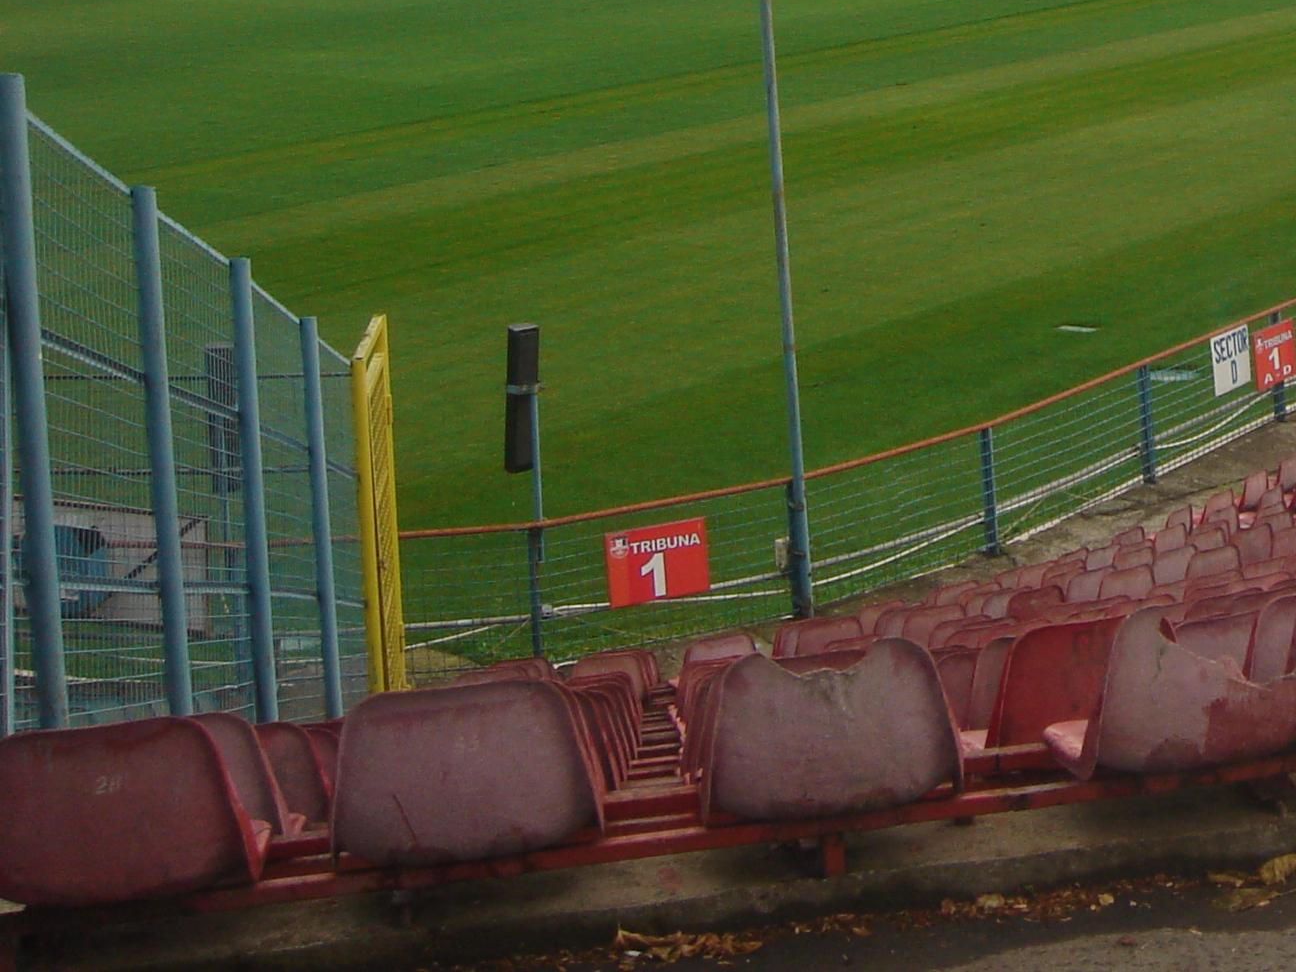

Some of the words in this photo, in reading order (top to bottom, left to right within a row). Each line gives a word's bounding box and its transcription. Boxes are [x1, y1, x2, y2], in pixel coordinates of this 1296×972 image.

[1213, 327, 1248, 364] SECTOR
[1268, 347, 1280, 370] 1
[1230, 360, 1238, 385] D
[630, 533, 701, 554] TRIBUNA
[641, 552, 667, 597] 1
